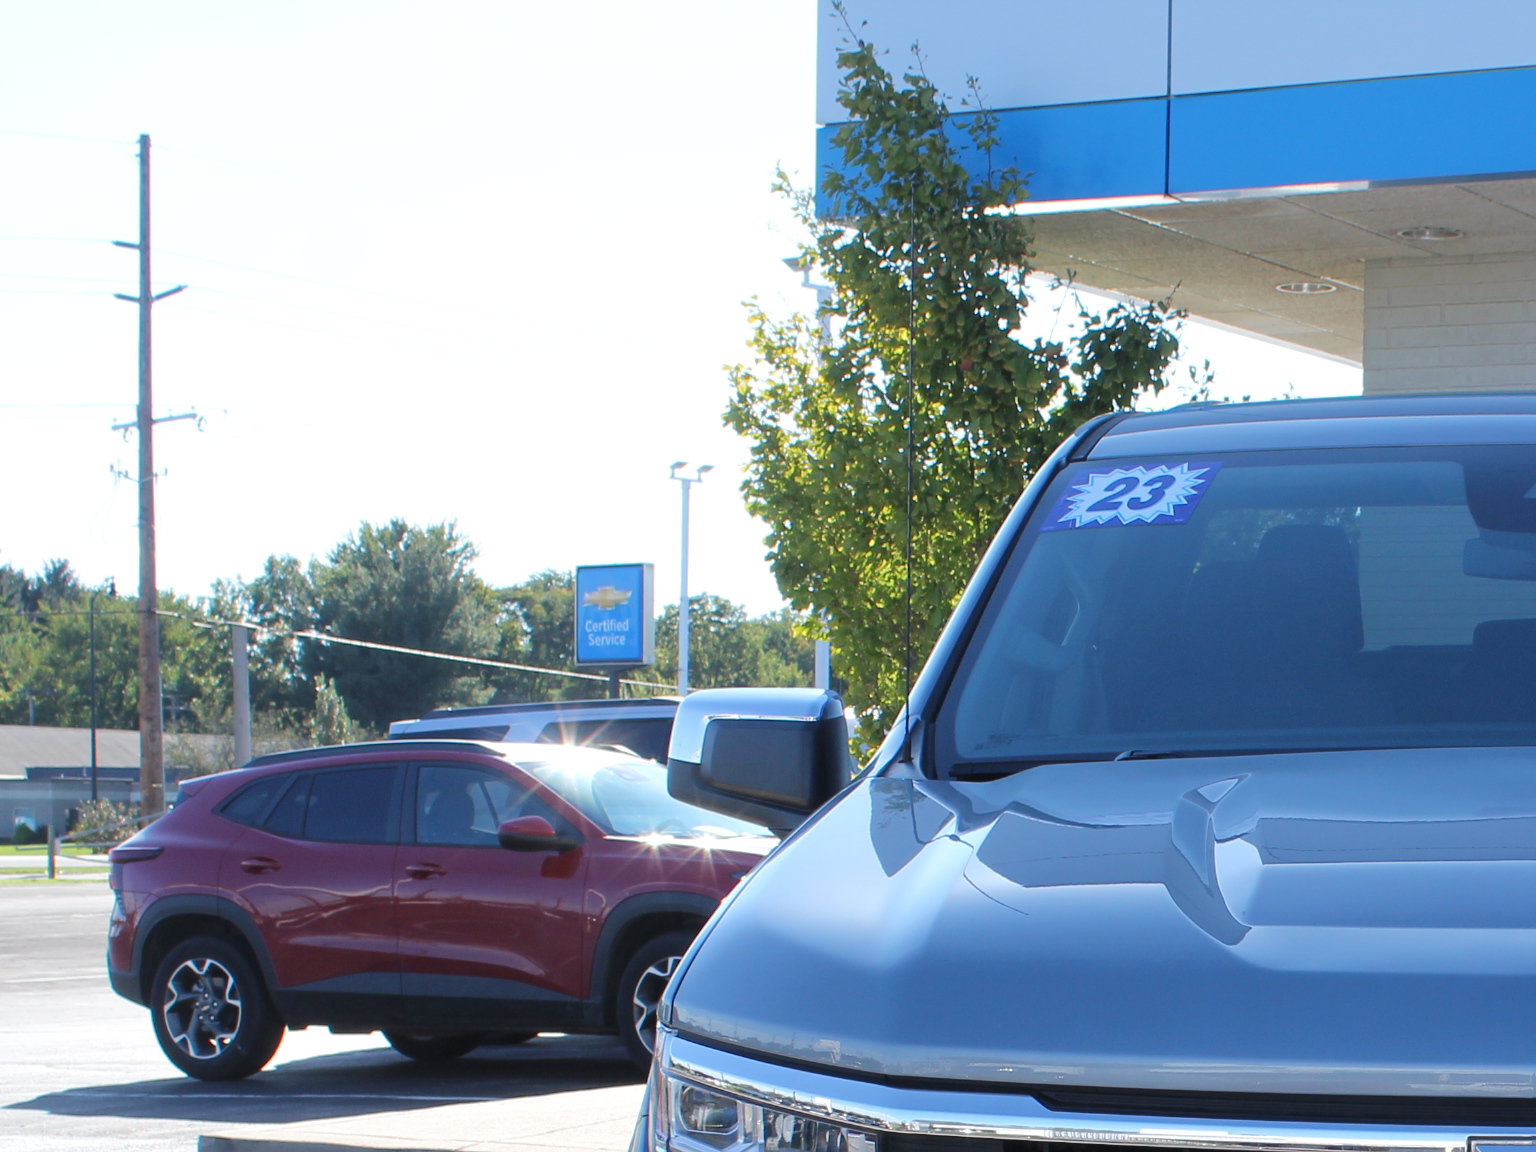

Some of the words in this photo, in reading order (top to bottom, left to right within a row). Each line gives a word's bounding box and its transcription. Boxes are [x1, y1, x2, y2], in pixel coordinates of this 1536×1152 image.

[1086, 475, 1176, 512] 23
[585, 619, 629, 632] Certified
[588, 633, 626, 646] Service
